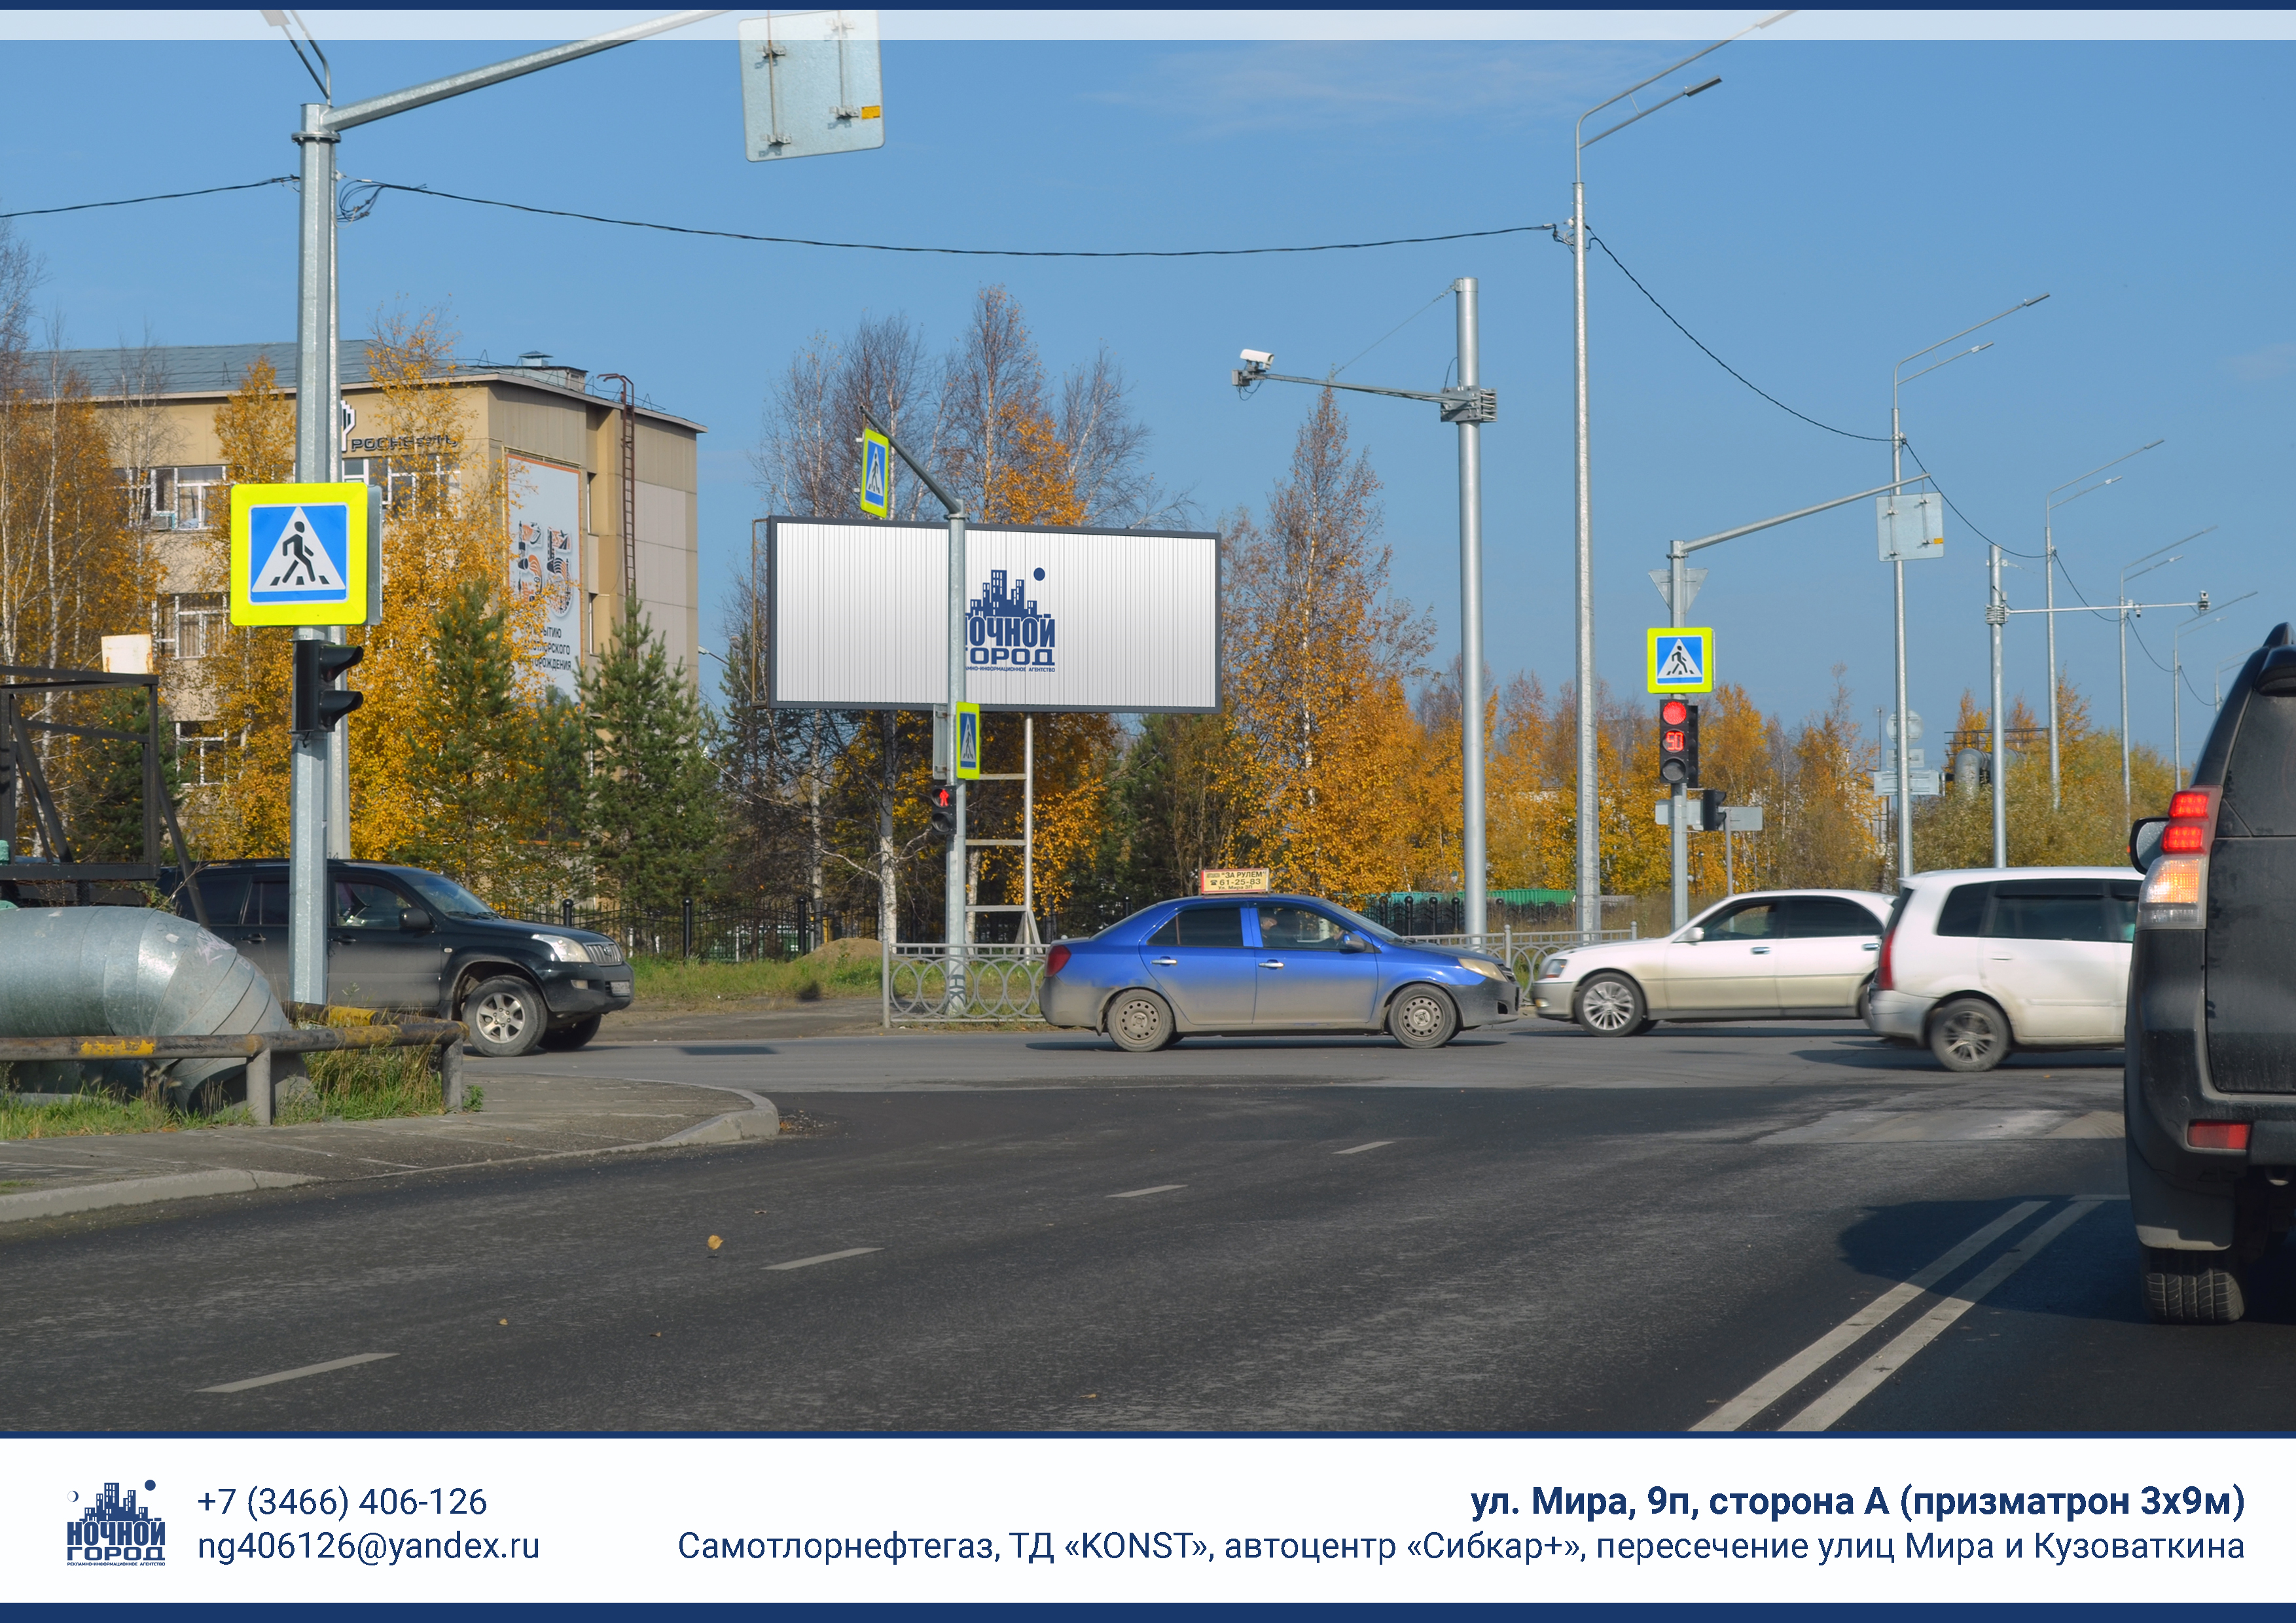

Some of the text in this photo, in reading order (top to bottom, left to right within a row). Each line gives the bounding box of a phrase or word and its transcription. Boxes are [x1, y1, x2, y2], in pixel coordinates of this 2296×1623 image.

[965, 614, 1055, 647] ОЧНОЙ
[965, 647, 1055, 666] ОРОД
[1666, 731, 1684, 751] 50
